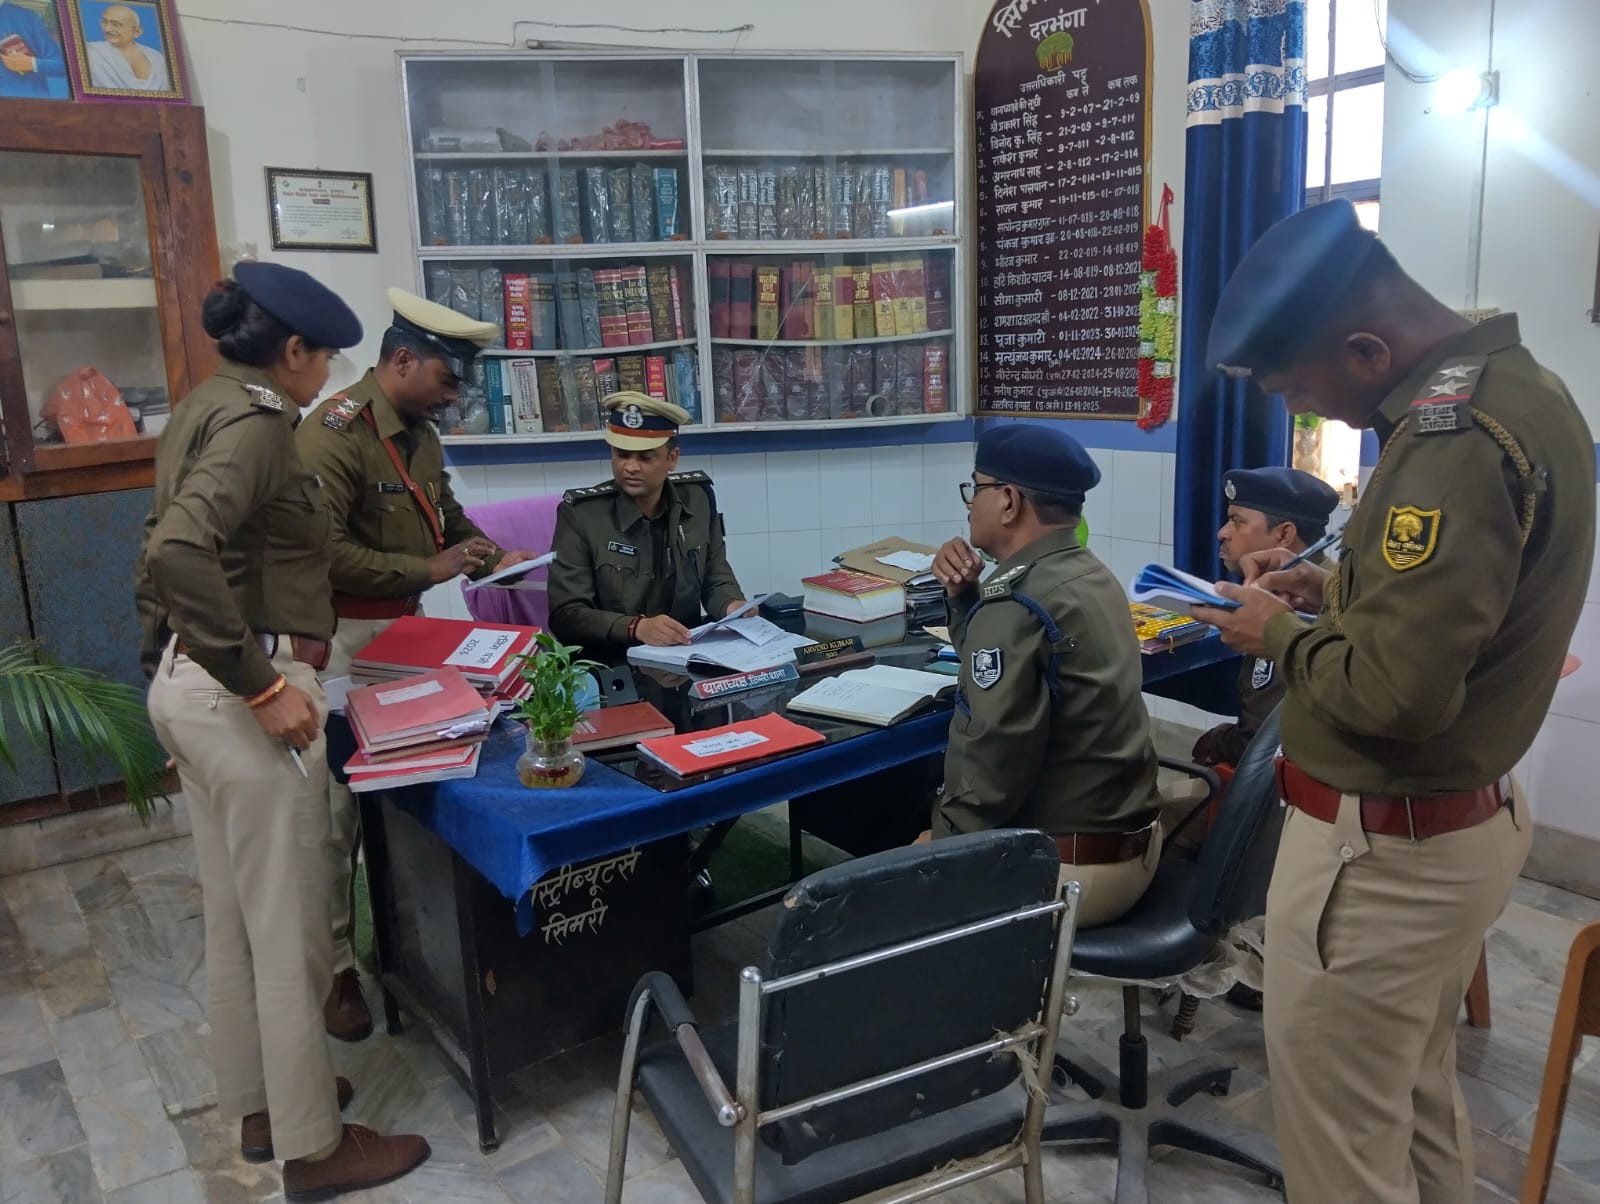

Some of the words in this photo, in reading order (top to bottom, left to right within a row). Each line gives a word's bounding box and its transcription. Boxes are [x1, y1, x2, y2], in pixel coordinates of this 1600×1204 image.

[1029, 8, 1087, 41] दरभंगा
[1021, 199, 1043, 213] कुमार
[1017, 329, 1046, 347] कुमारी
[803, 643, 829, 655] ARVIND
[829, 638, 854, 650] KUMAR
[541, 898, 608, 945] सिमरी
